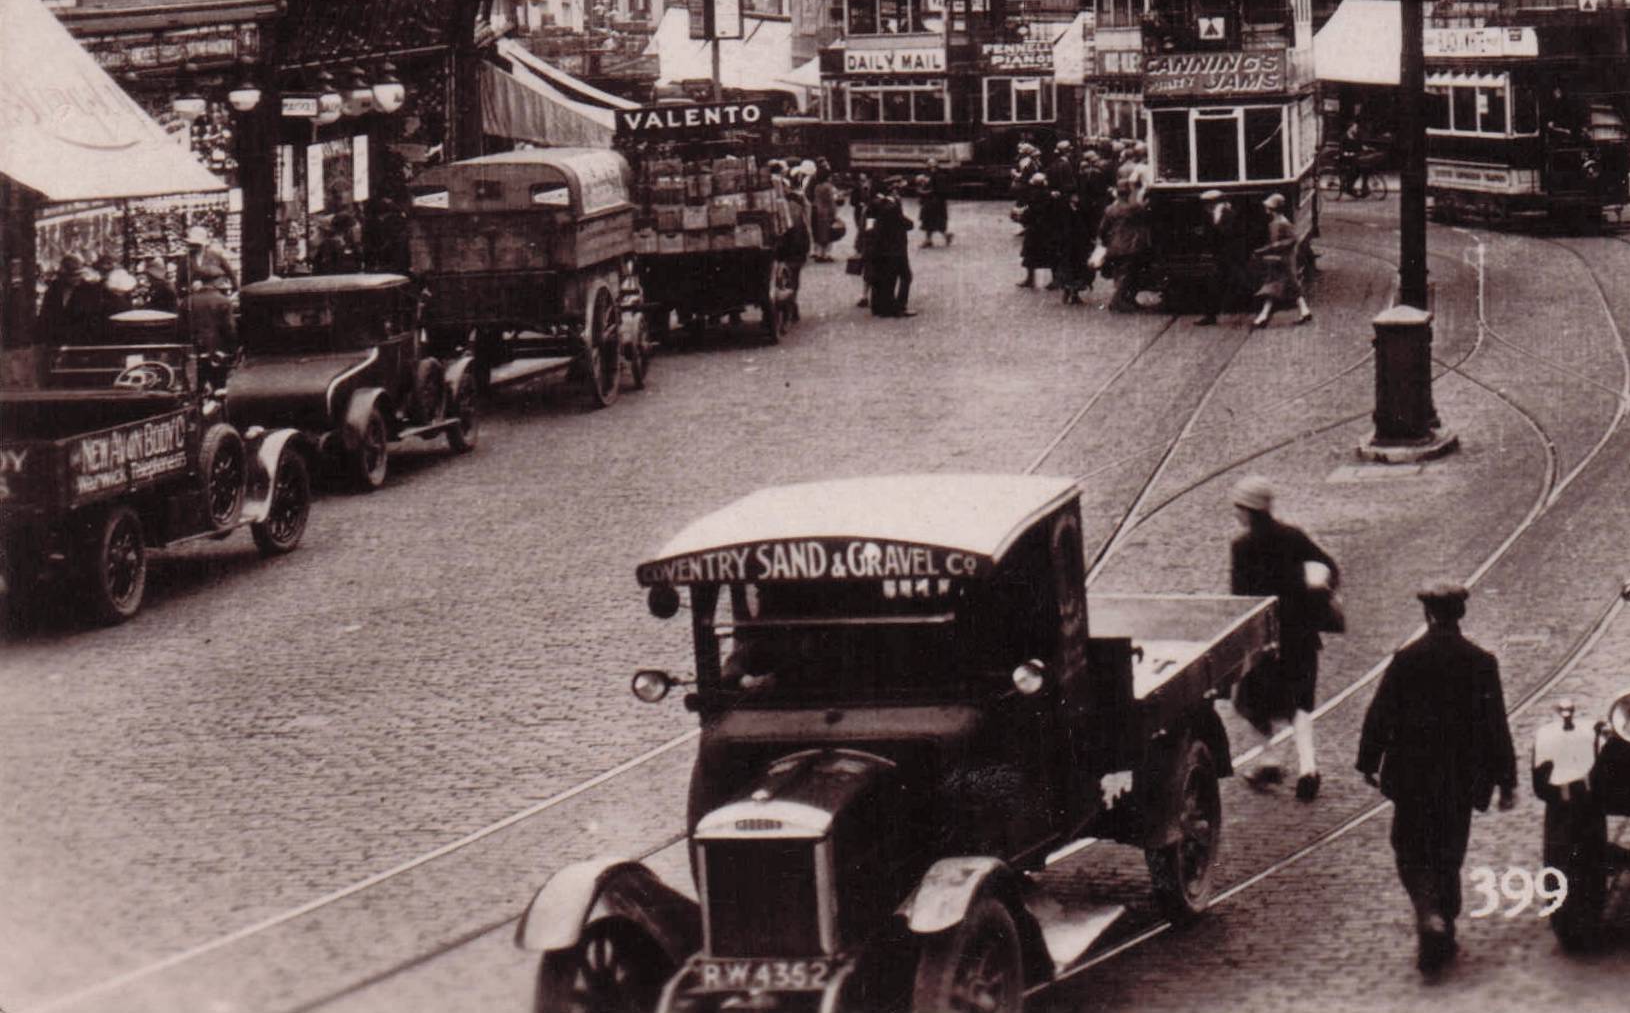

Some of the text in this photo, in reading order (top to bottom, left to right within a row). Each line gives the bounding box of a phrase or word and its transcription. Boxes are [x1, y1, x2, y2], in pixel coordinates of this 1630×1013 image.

[848, 51, 942, 71] DAILY MAIL
[623, 104, 761, 130] VALENTO
[642, 546, 750, 583] COVENTRY
[756, 541, 826, 580] SAND
[831, 552, 847, 578] &
[848, 541, 940, 578] GRAVEL
